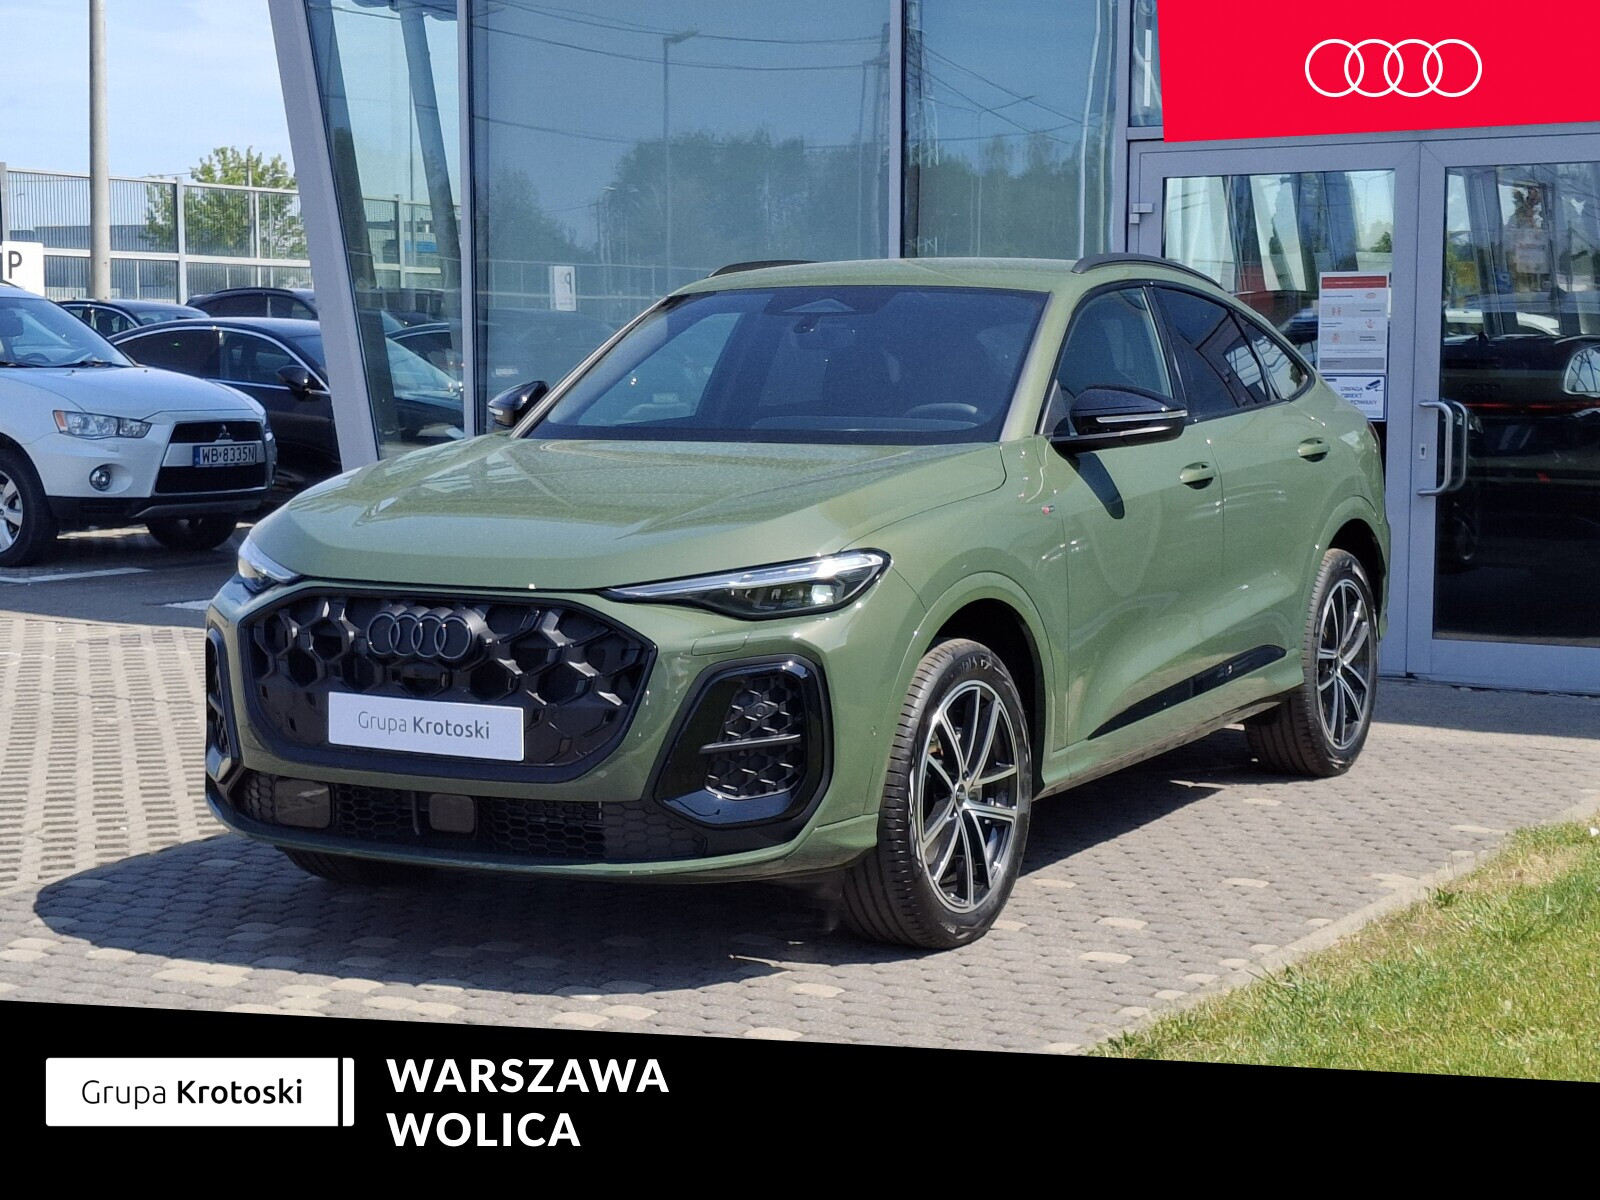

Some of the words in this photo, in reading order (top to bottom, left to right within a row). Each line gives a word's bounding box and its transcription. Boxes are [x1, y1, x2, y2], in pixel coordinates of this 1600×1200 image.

[8, 250, 23, 279] P
[202, 447, 219, 463] WB
[357, 710, 407, 735] Grupa
[412, 716, 490, 740] Krotoski
